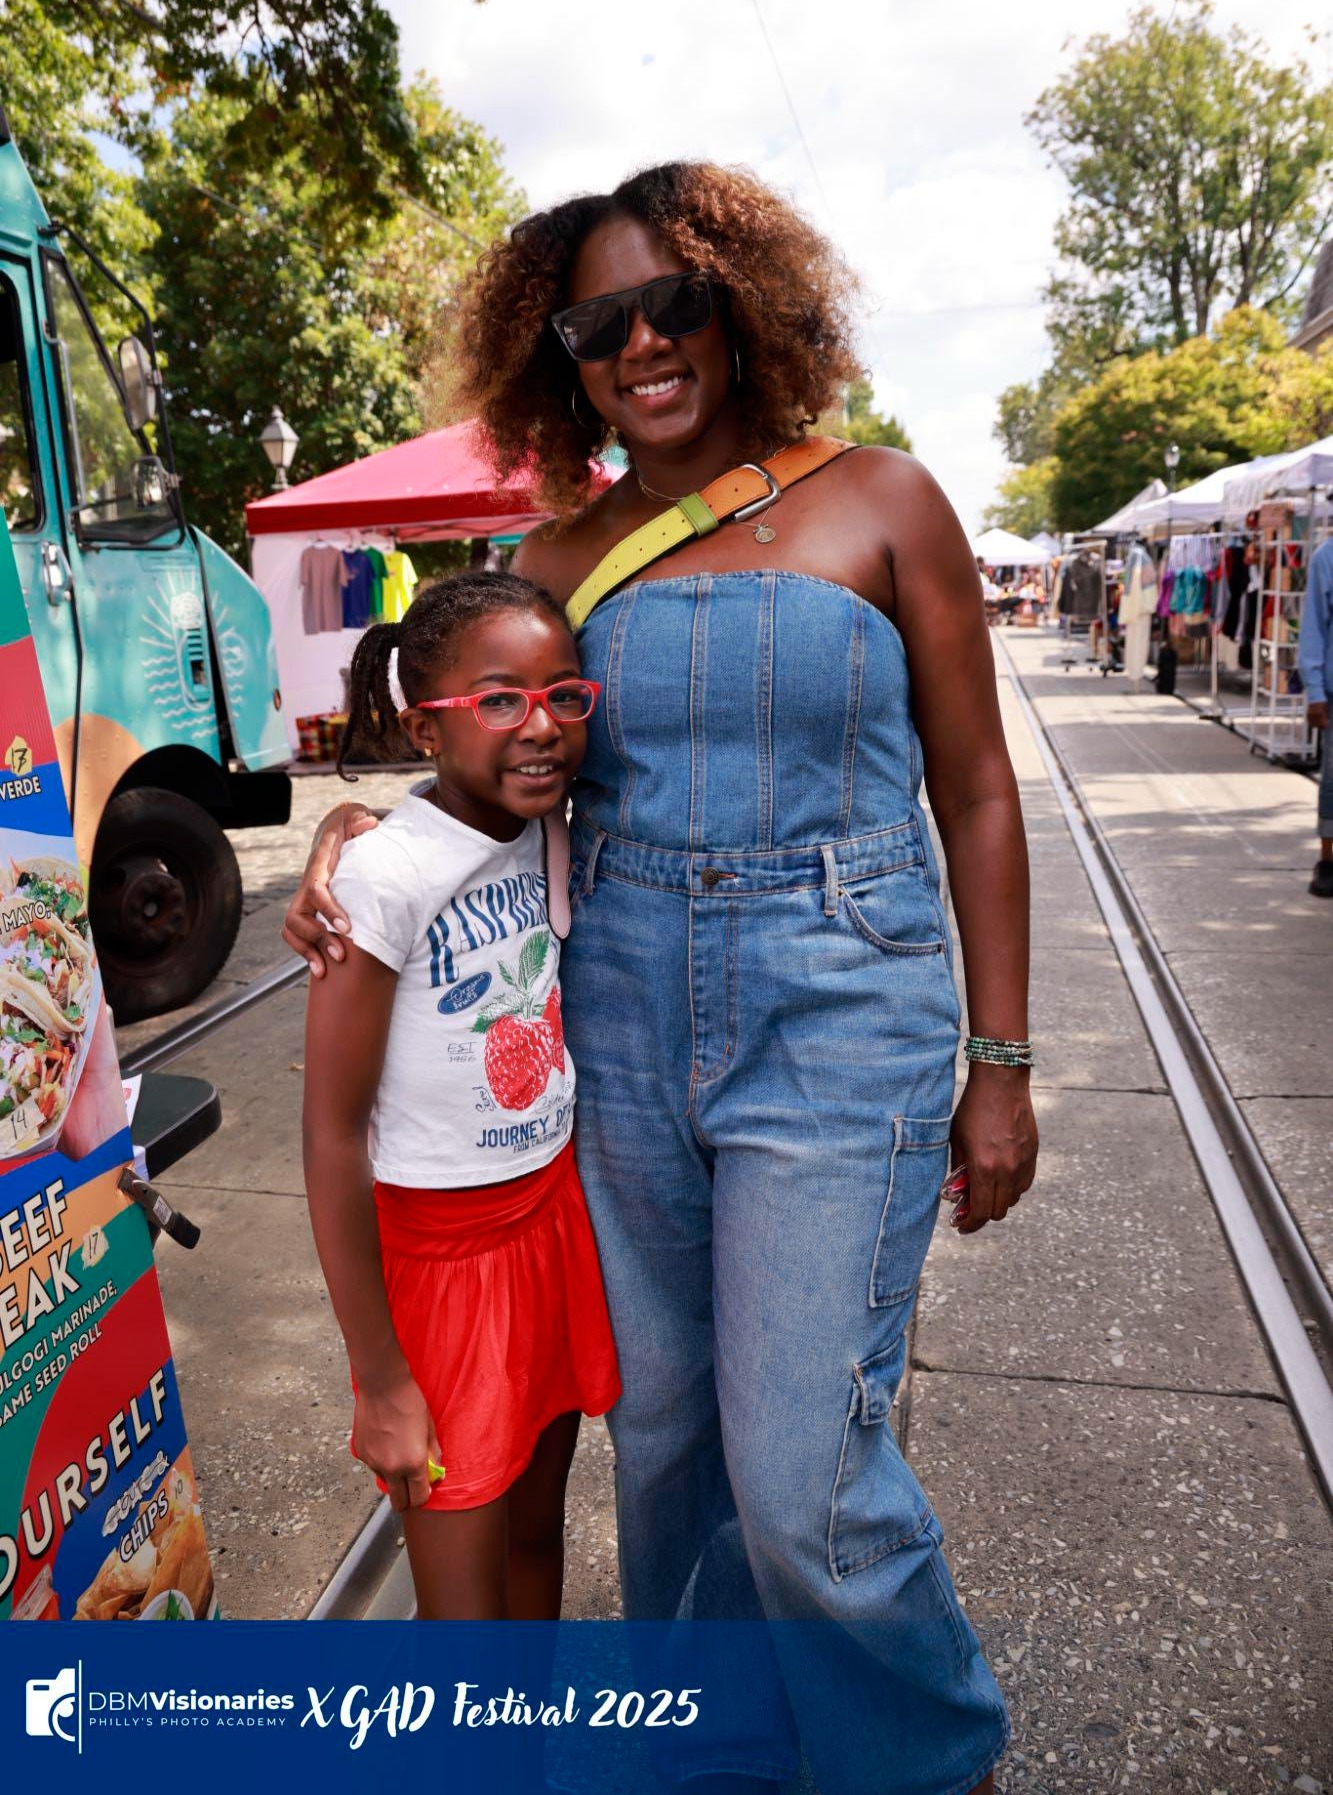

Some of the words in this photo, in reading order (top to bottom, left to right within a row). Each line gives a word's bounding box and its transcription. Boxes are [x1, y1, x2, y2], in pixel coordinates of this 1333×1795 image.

[11, 1109, 28, 1140] 14
[476, 1115, 550, 1148] JOURNEY
[0, 1178, 68, 1276] EEF
[88, 1231, 99, 1259] 17
[51, 1279, 118, 1348] MARINADE,
[0, 1382, 33, 1428] AME
[35, 1353, 67, 1393] SEED
[69, 1321, 103, 1362] ROLL
[120, 1489, 169, 1562] CHIPS
